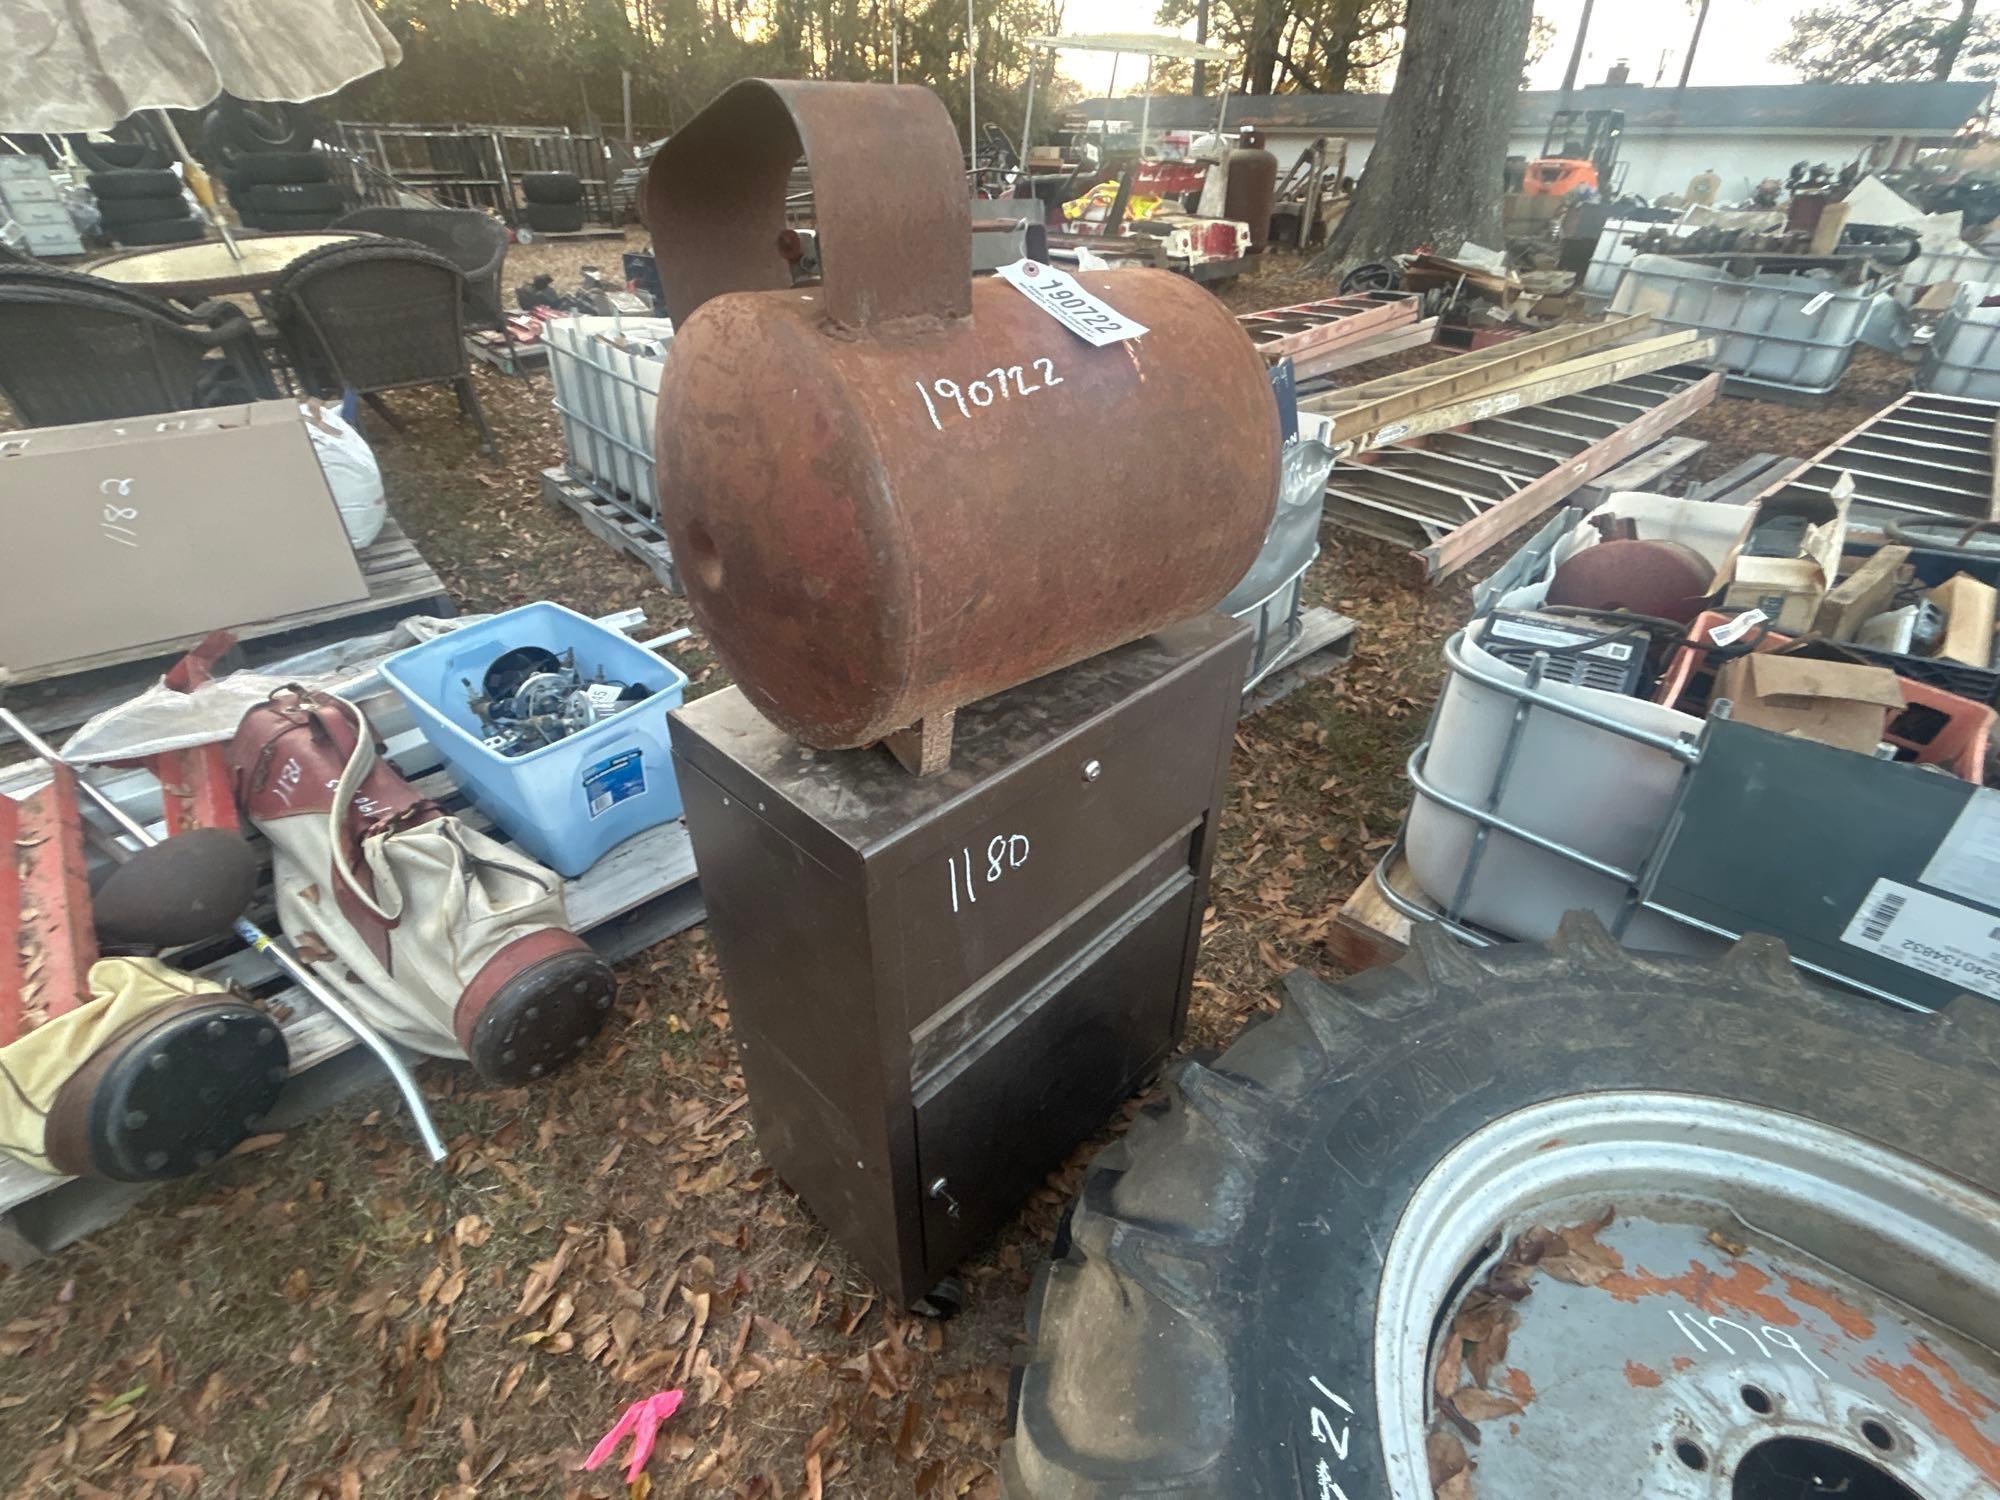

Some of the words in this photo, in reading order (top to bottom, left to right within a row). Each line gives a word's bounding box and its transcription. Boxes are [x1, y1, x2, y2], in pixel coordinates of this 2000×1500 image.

[1040, 279, 1122, 334] 190722
[915, 358, 1064, 430] 190722
[100, 478, 138, 547] 1182
[948, 834, 1029, 913] 1180
[1667, 1309, 1830, 1380] 1179
